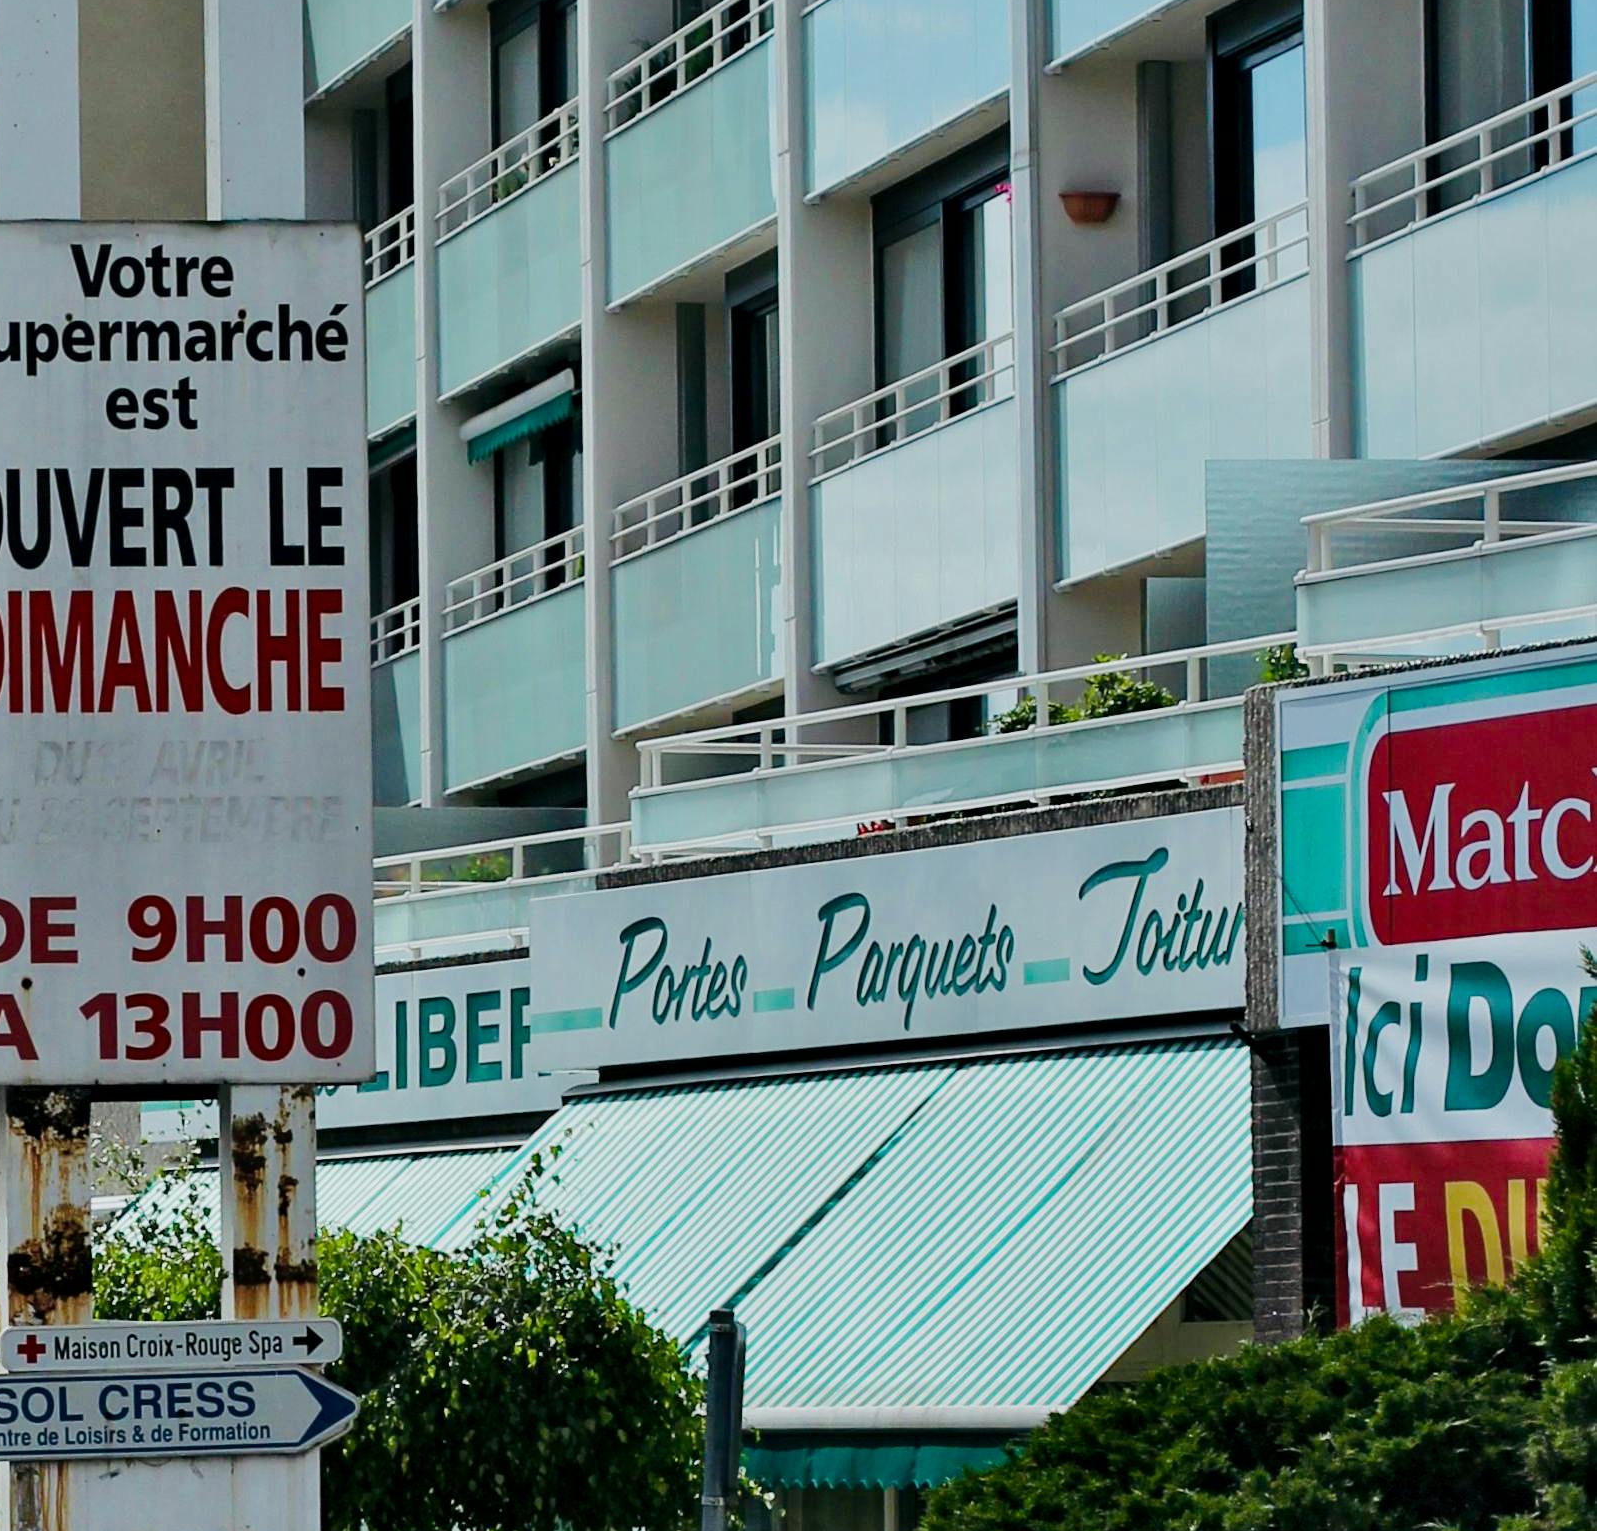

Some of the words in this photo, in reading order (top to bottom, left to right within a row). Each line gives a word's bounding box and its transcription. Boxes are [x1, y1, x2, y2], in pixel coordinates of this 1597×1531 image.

[70, 243, 235, 300] Votre
[104, 375, 200, 432] est
[268, 467, 345, 567] LE
[1382, 769, 1597, 896] Matc
[127, 892, 358, 966] 9H00
[608, 915, 748, 1030] Portes
[806, 891, 1015, 1032] Parquets
[79, 991, 355, 1064] 13H00
[1343, 953, 1429, 1118] Ici
[1343, 1181, 1426, 1330] LE
[54, 1335, 121, 1361] Maison
[126, 1331, 243, 1363] Croix-Rouge
[248, 1330, 283, 1361] Spa
[37, 1427, 59, 1446] de
[64, 1425, 127, 1446] Loisirs
[131, 1425, 145, 1444] &
[150, 1424, 173, 1444] de
[178, 1420, 271, 1442] Formation
[98, 1380, 257, 1422] CRESS
